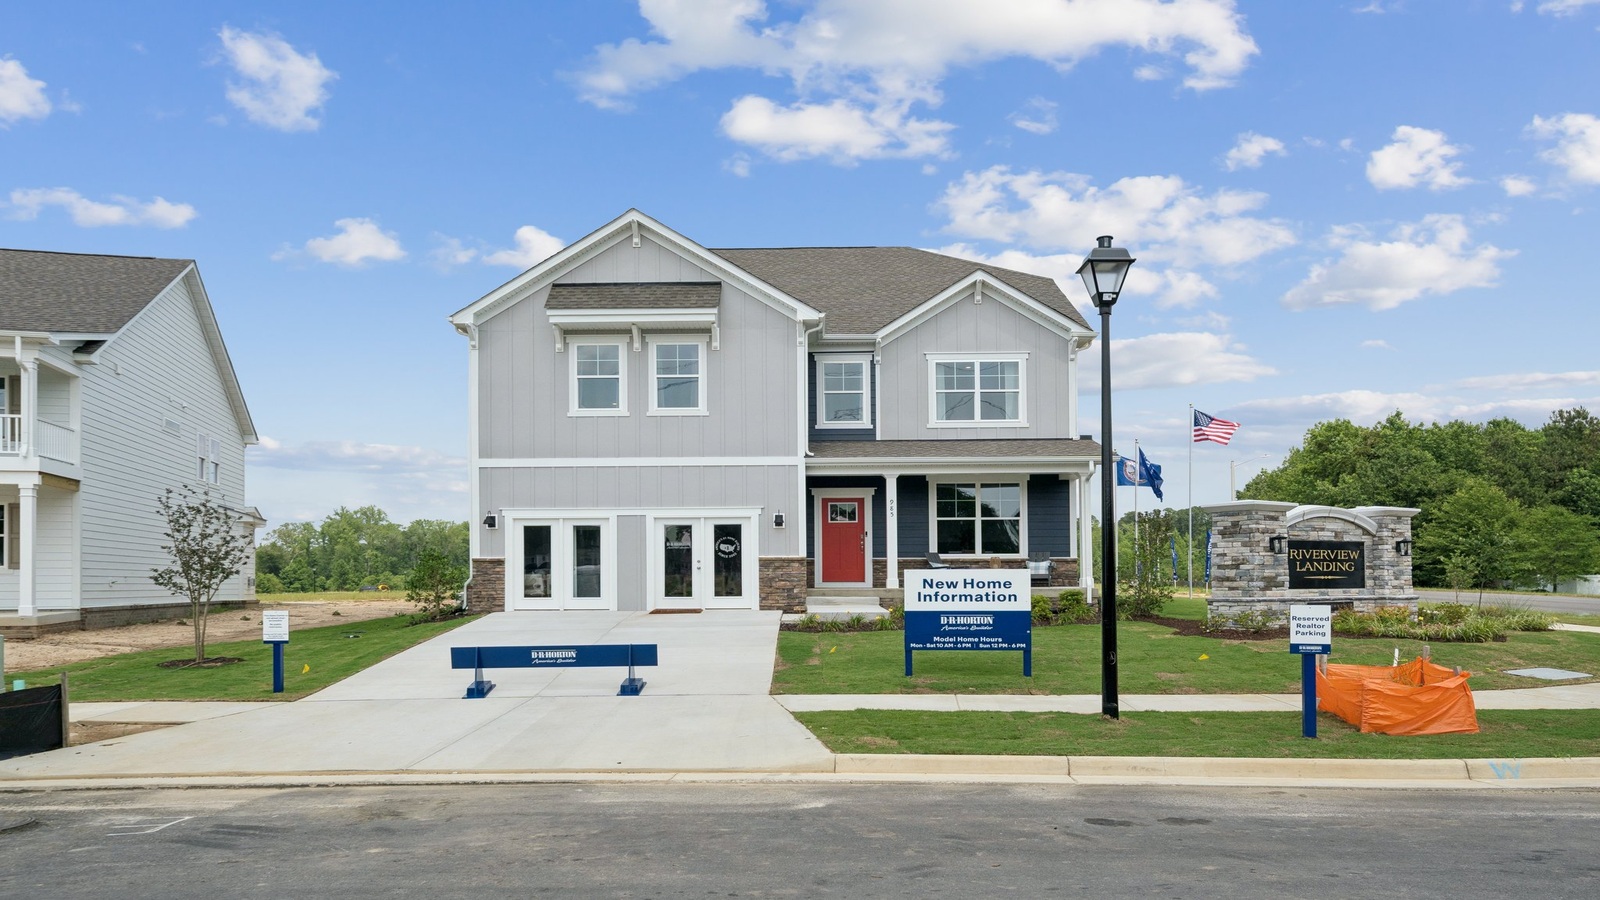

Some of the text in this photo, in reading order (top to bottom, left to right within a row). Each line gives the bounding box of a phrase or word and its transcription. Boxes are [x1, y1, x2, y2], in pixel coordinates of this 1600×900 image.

[1290, 549, 1360, 560] RIVERVIEW
[1296, 562, 1355, 572] LANDING
[922, 578, 1012, 589] New Home
[918, 591, 1018, 602] Information
